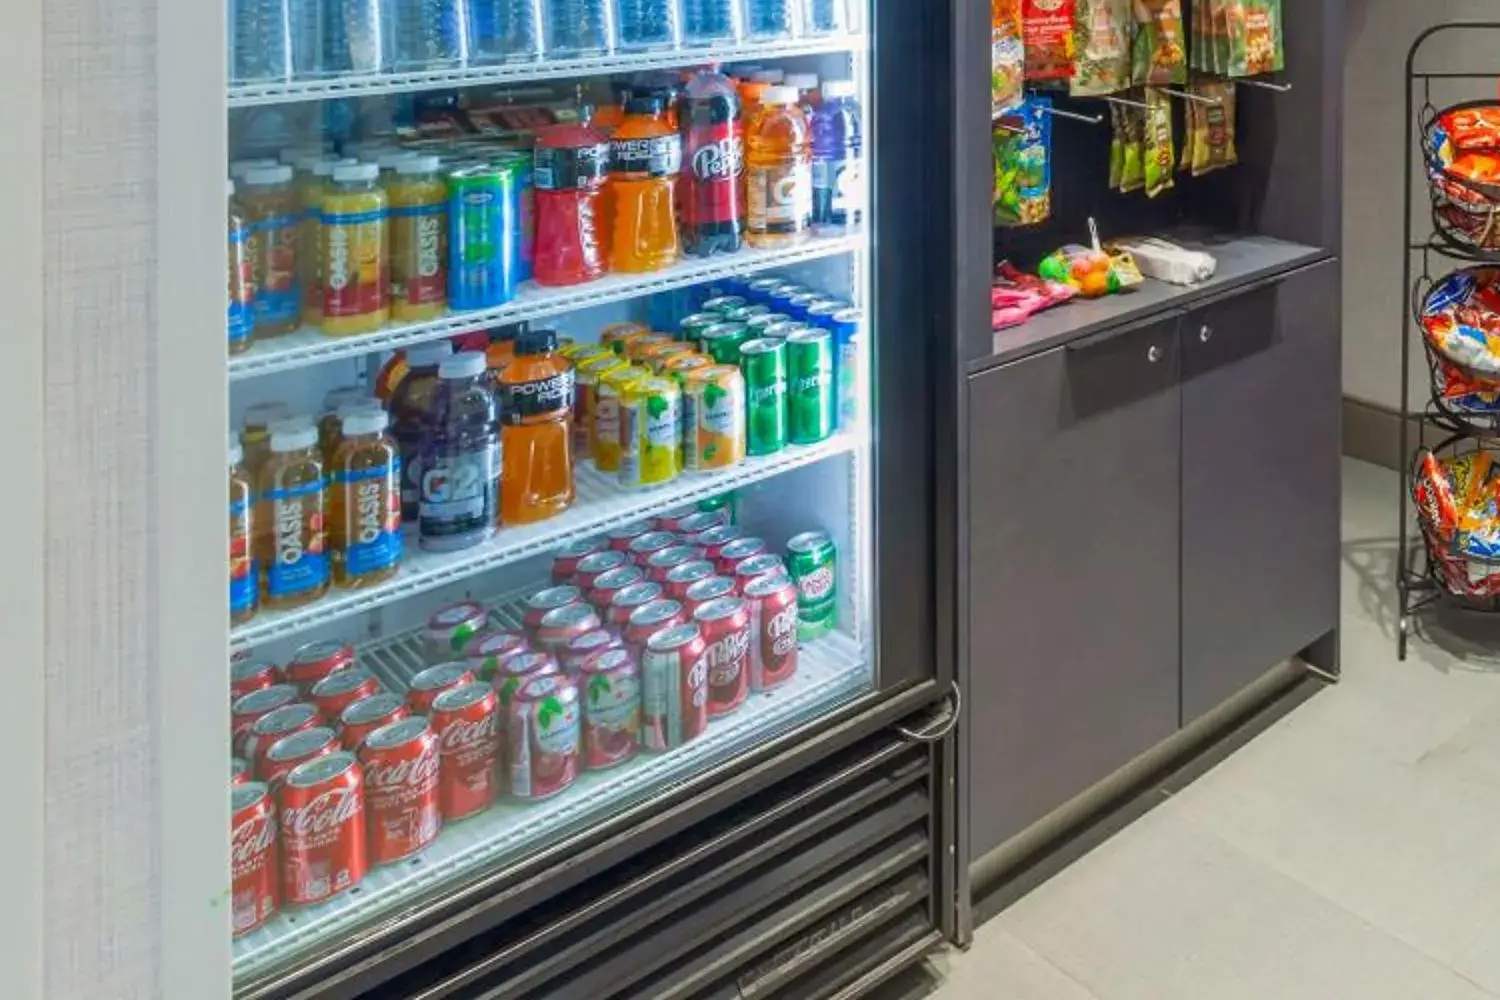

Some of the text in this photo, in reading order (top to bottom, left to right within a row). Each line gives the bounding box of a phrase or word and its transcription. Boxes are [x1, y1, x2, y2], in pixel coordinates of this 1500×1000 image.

[415, 216, 440, 277] OASIS
[278, 500, 301, 564] OASIS
[358, 483, 381, 543] OASIS
